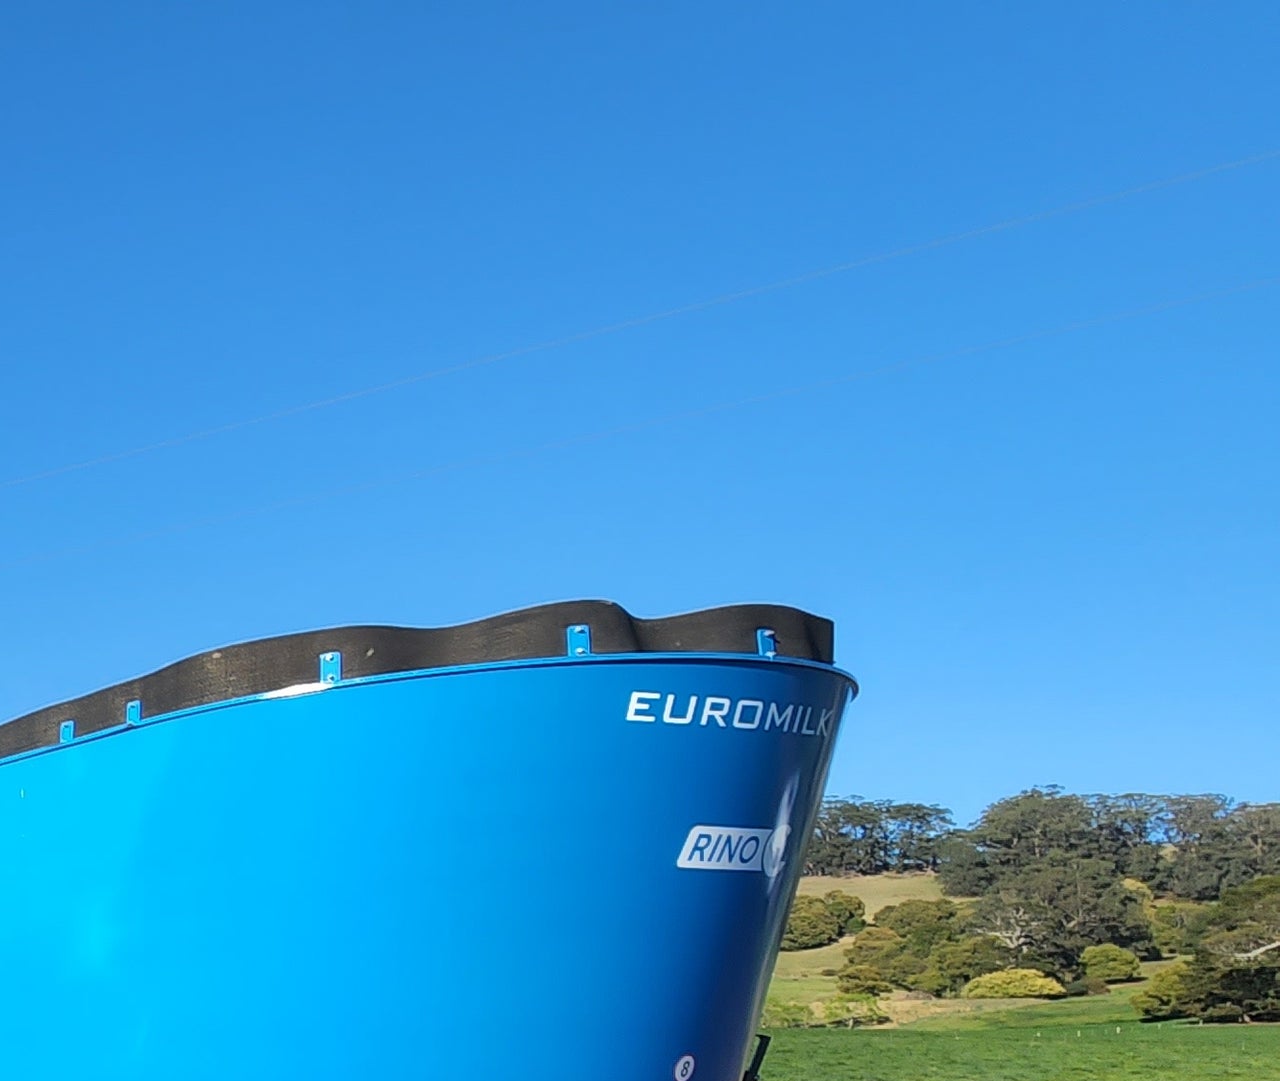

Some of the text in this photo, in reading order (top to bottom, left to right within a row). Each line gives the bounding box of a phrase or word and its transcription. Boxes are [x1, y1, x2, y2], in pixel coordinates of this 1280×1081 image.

[625, 690, 833, 737] EUROMILK
[687, 833, 761, 864] RINO
[680, 1060, 691, 1078] 8
